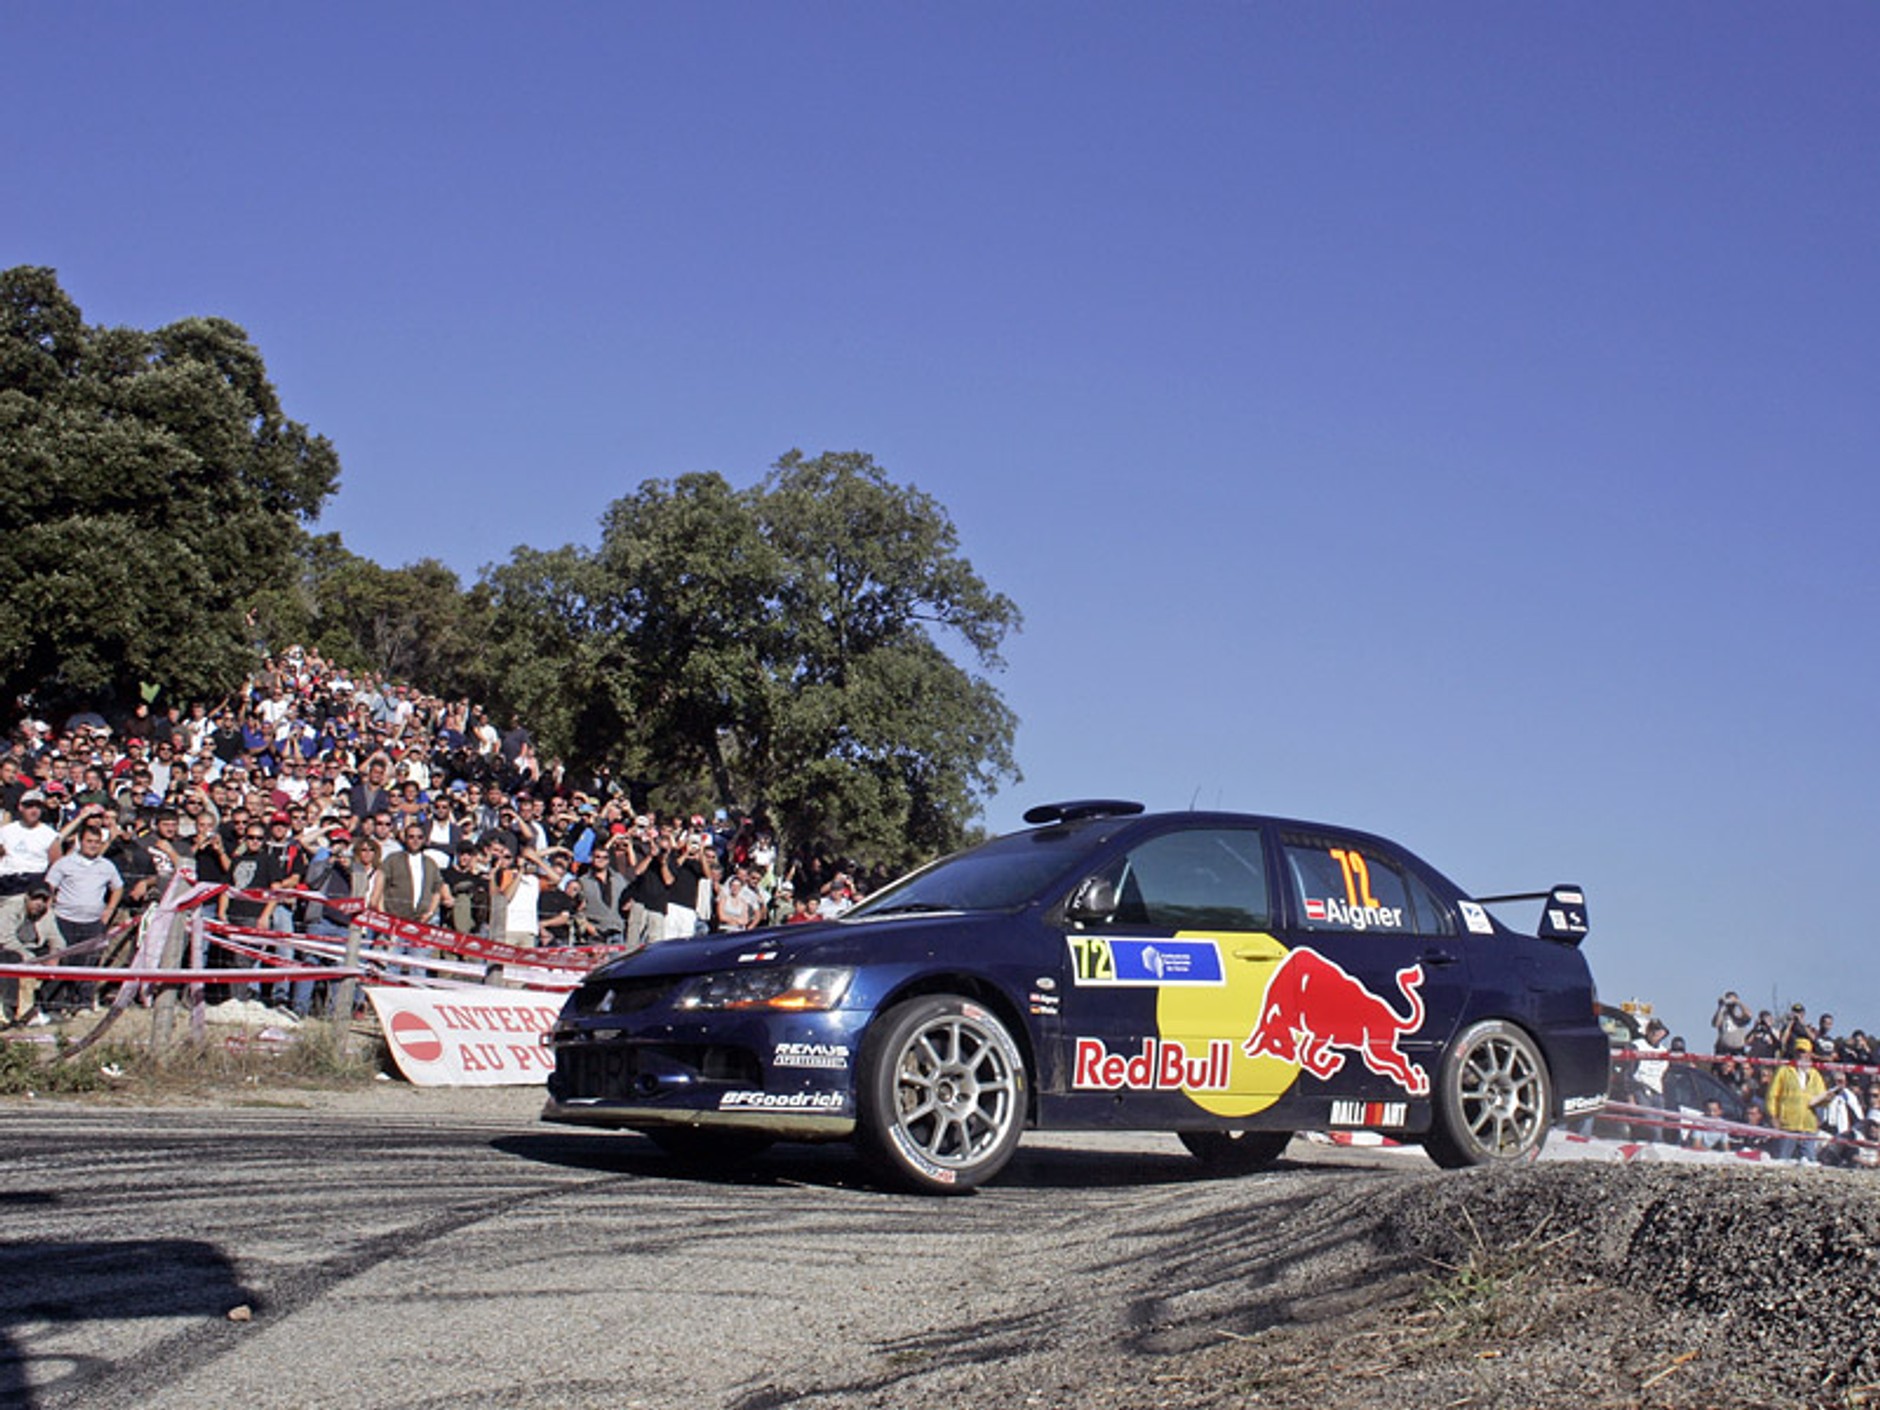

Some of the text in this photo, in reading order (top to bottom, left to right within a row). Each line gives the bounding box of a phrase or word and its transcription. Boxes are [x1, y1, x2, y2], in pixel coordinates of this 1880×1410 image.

[1329, 848, 1380, 909] 72
[1327, 897, 1402, 931] Aigner
[1071, 938, 1113, 979] 72
[433, 1004, 561, 1033] INTERD
[458, 1043, 504, 1071] AU
[775, 1043, 849, 1056] REMUS
[1075, 1038, 1232, 1089] Red Bull
[720, 1091, 843, 1107] BFGoodrich
